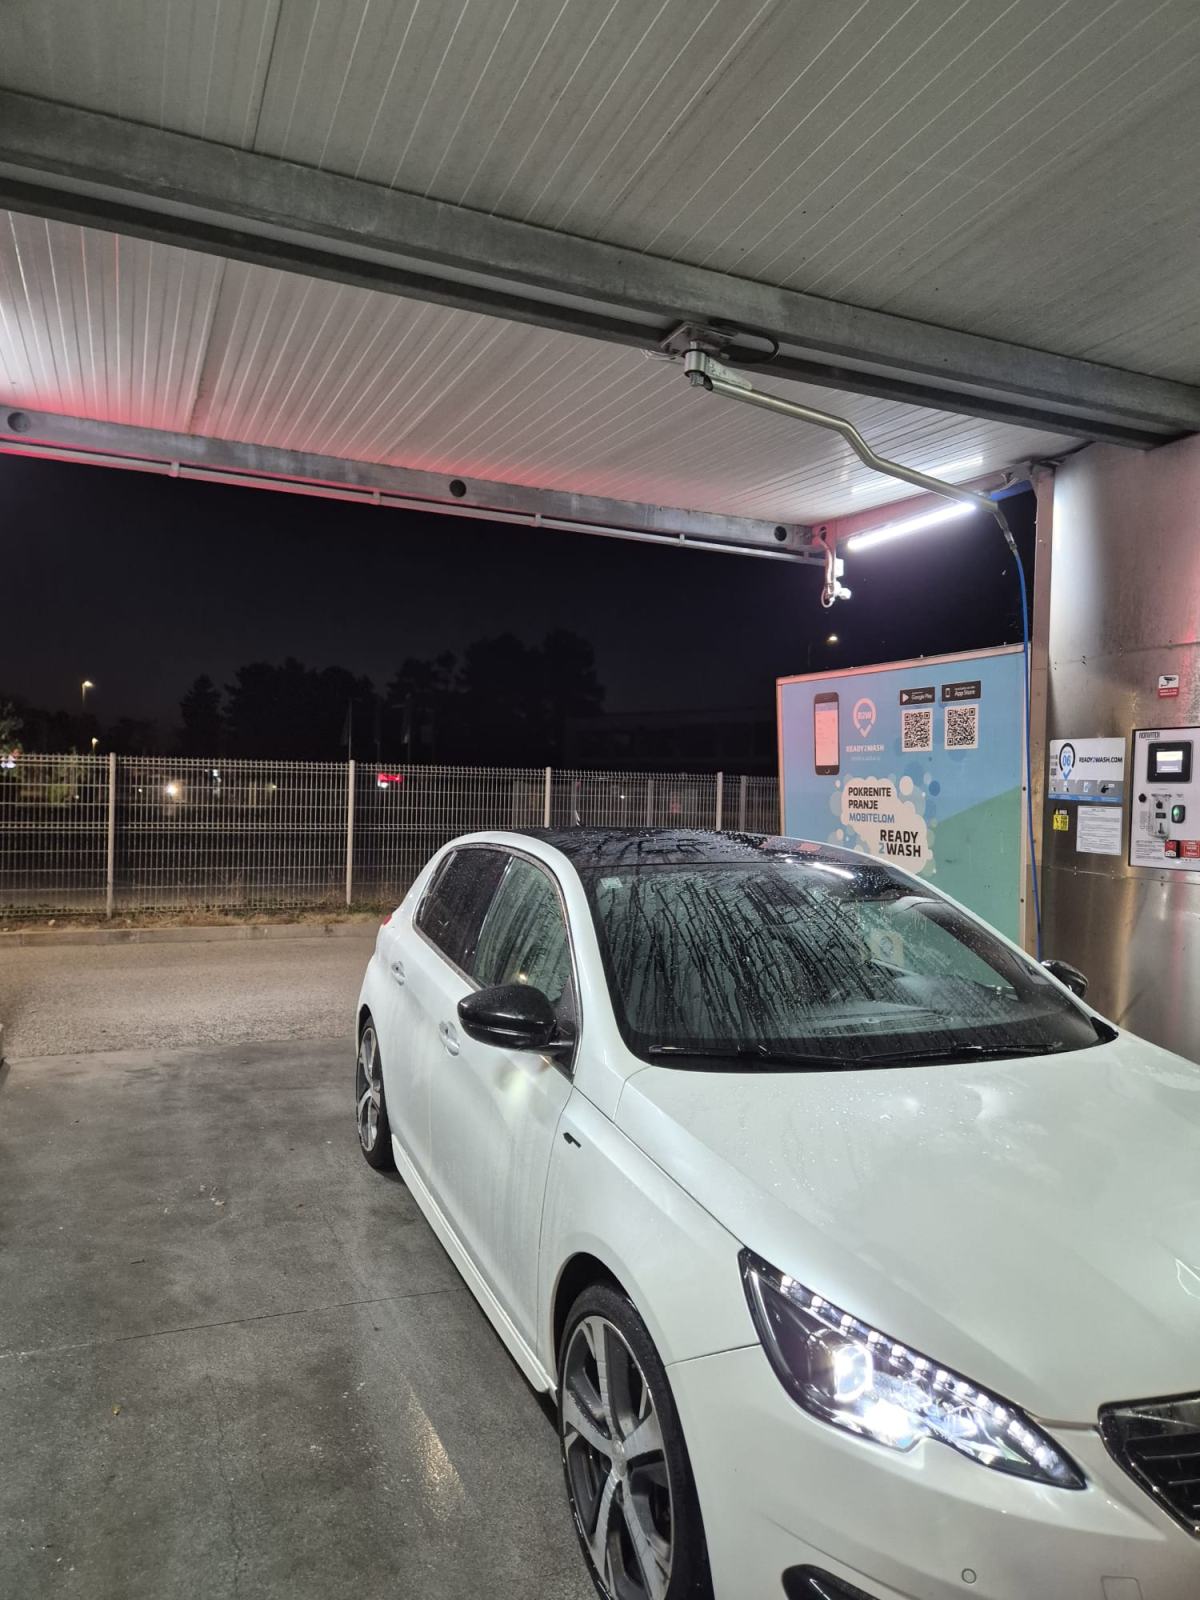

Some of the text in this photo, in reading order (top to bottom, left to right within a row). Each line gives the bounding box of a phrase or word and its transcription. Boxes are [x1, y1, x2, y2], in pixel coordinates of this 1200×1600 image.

[848, 786, 892, 797] POKRENITE
[848, 799, 879, 810] PRANJE
[848, 812, 895, 824] MOBITELOM
[880, 829, 919, 844] READY
